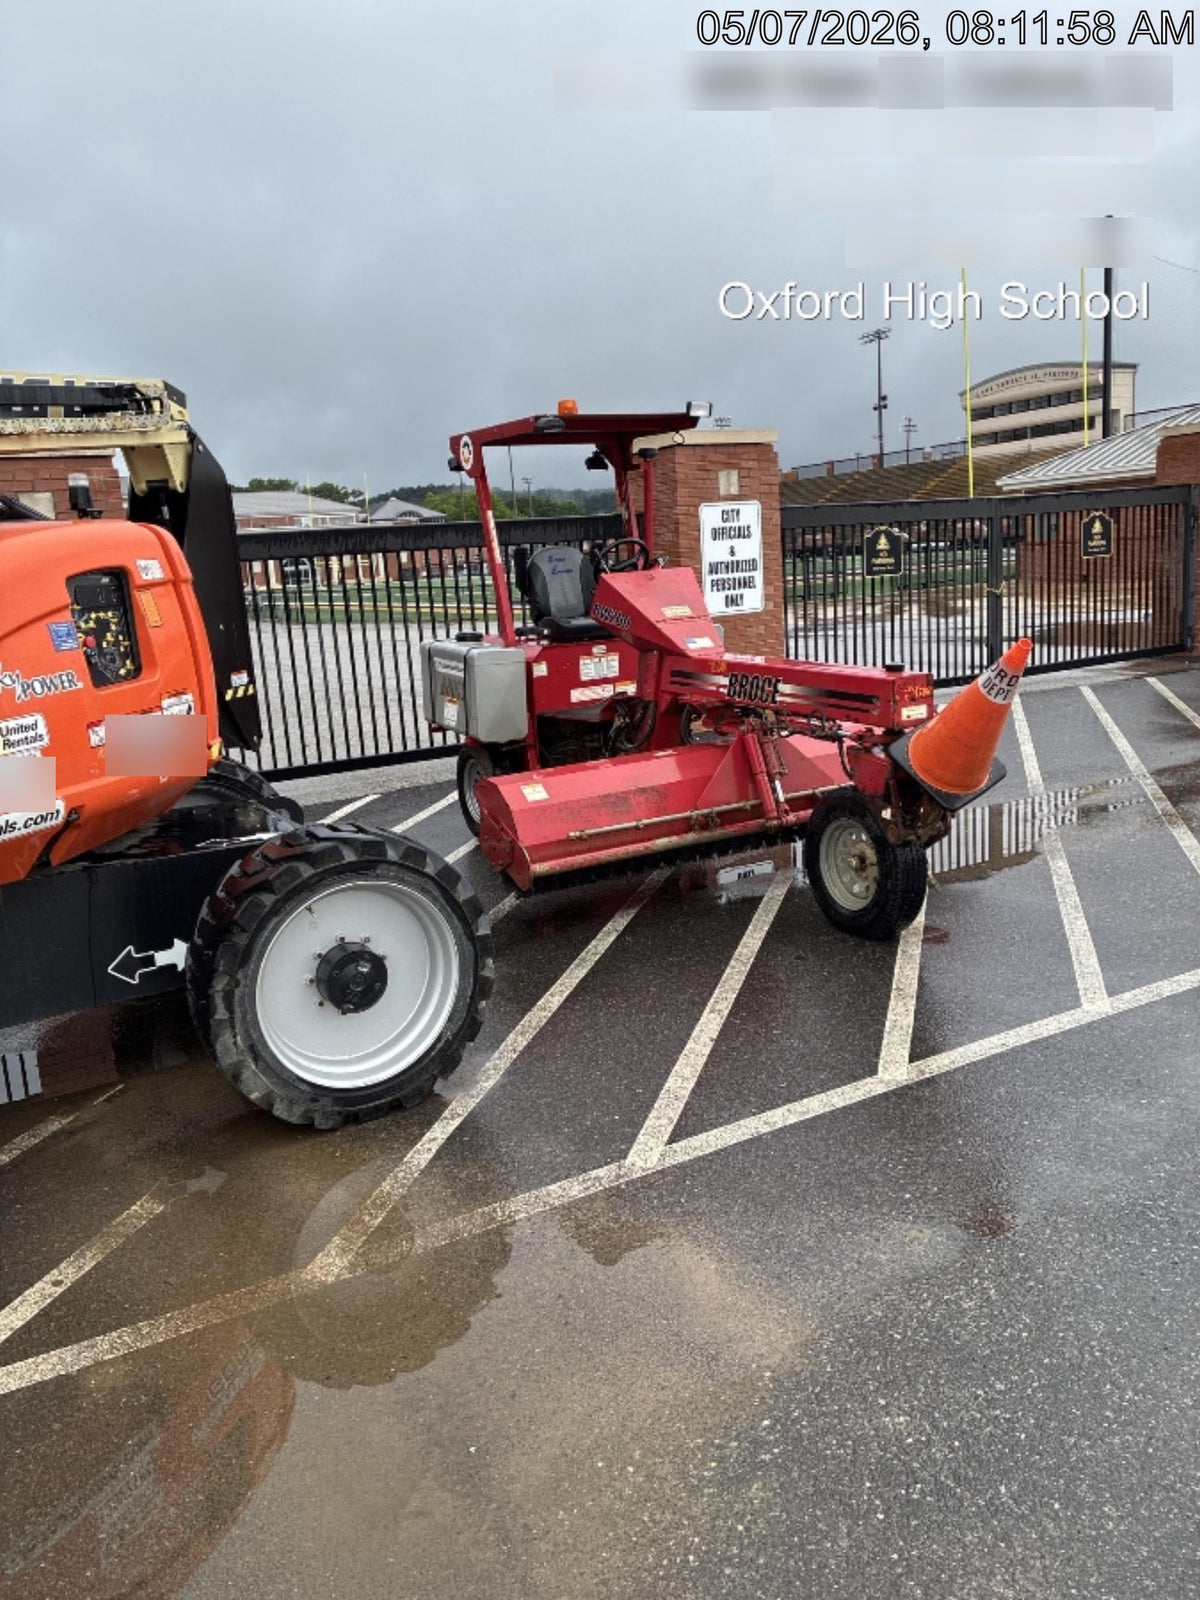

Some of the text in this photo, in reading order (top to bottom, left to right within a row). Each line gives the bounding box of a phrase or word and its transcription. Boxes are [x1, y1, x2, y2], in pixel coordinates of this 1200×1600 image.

[721, 508, 741, 523] CITY
[711, 524, 752, 541] OFFICIALS
[708, 558, 758, 576] AUTHORIZED
[711, 575, 757, 592] PERSONNEL
[725, 593, 744, 608] ONLY
[983, 676, 1012, 701] DEPT
[1, 719, 39, 738] United
[3, 731, 45, 751] Rentals
